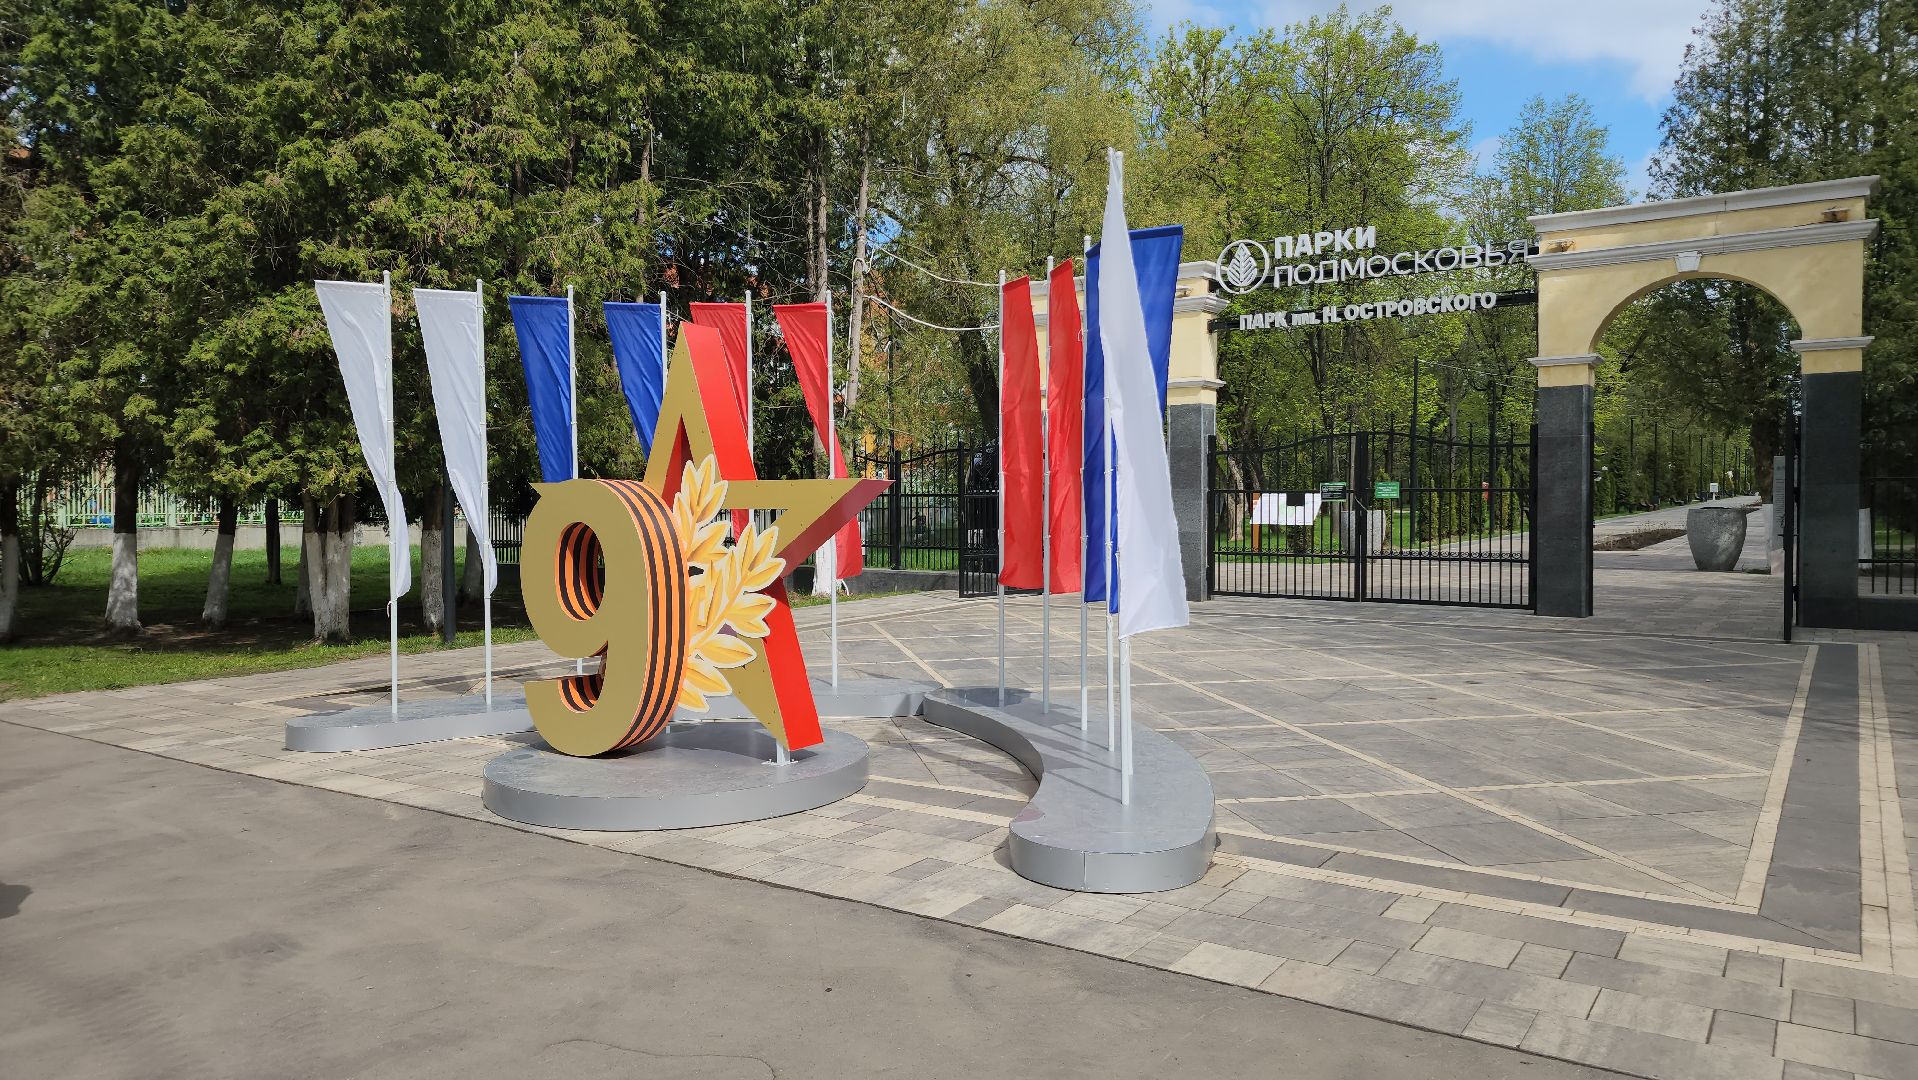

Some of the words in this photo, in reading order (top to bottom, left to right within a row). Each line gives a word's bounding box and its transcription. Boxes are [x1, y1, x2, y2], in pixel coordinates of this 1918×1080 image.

[1273, 239, 1528, 288] ПОДМОСКОВЬЯ
[1274, 226, 1376, 259] ПАРКИ
[1239, 312, 1288, 330] ПАРК
[1323, 306, 1341, 323] Н.
[1344, 291, 1497, 321] ОСТРОВСКОГО
[521, 478, 655, 757] 9
